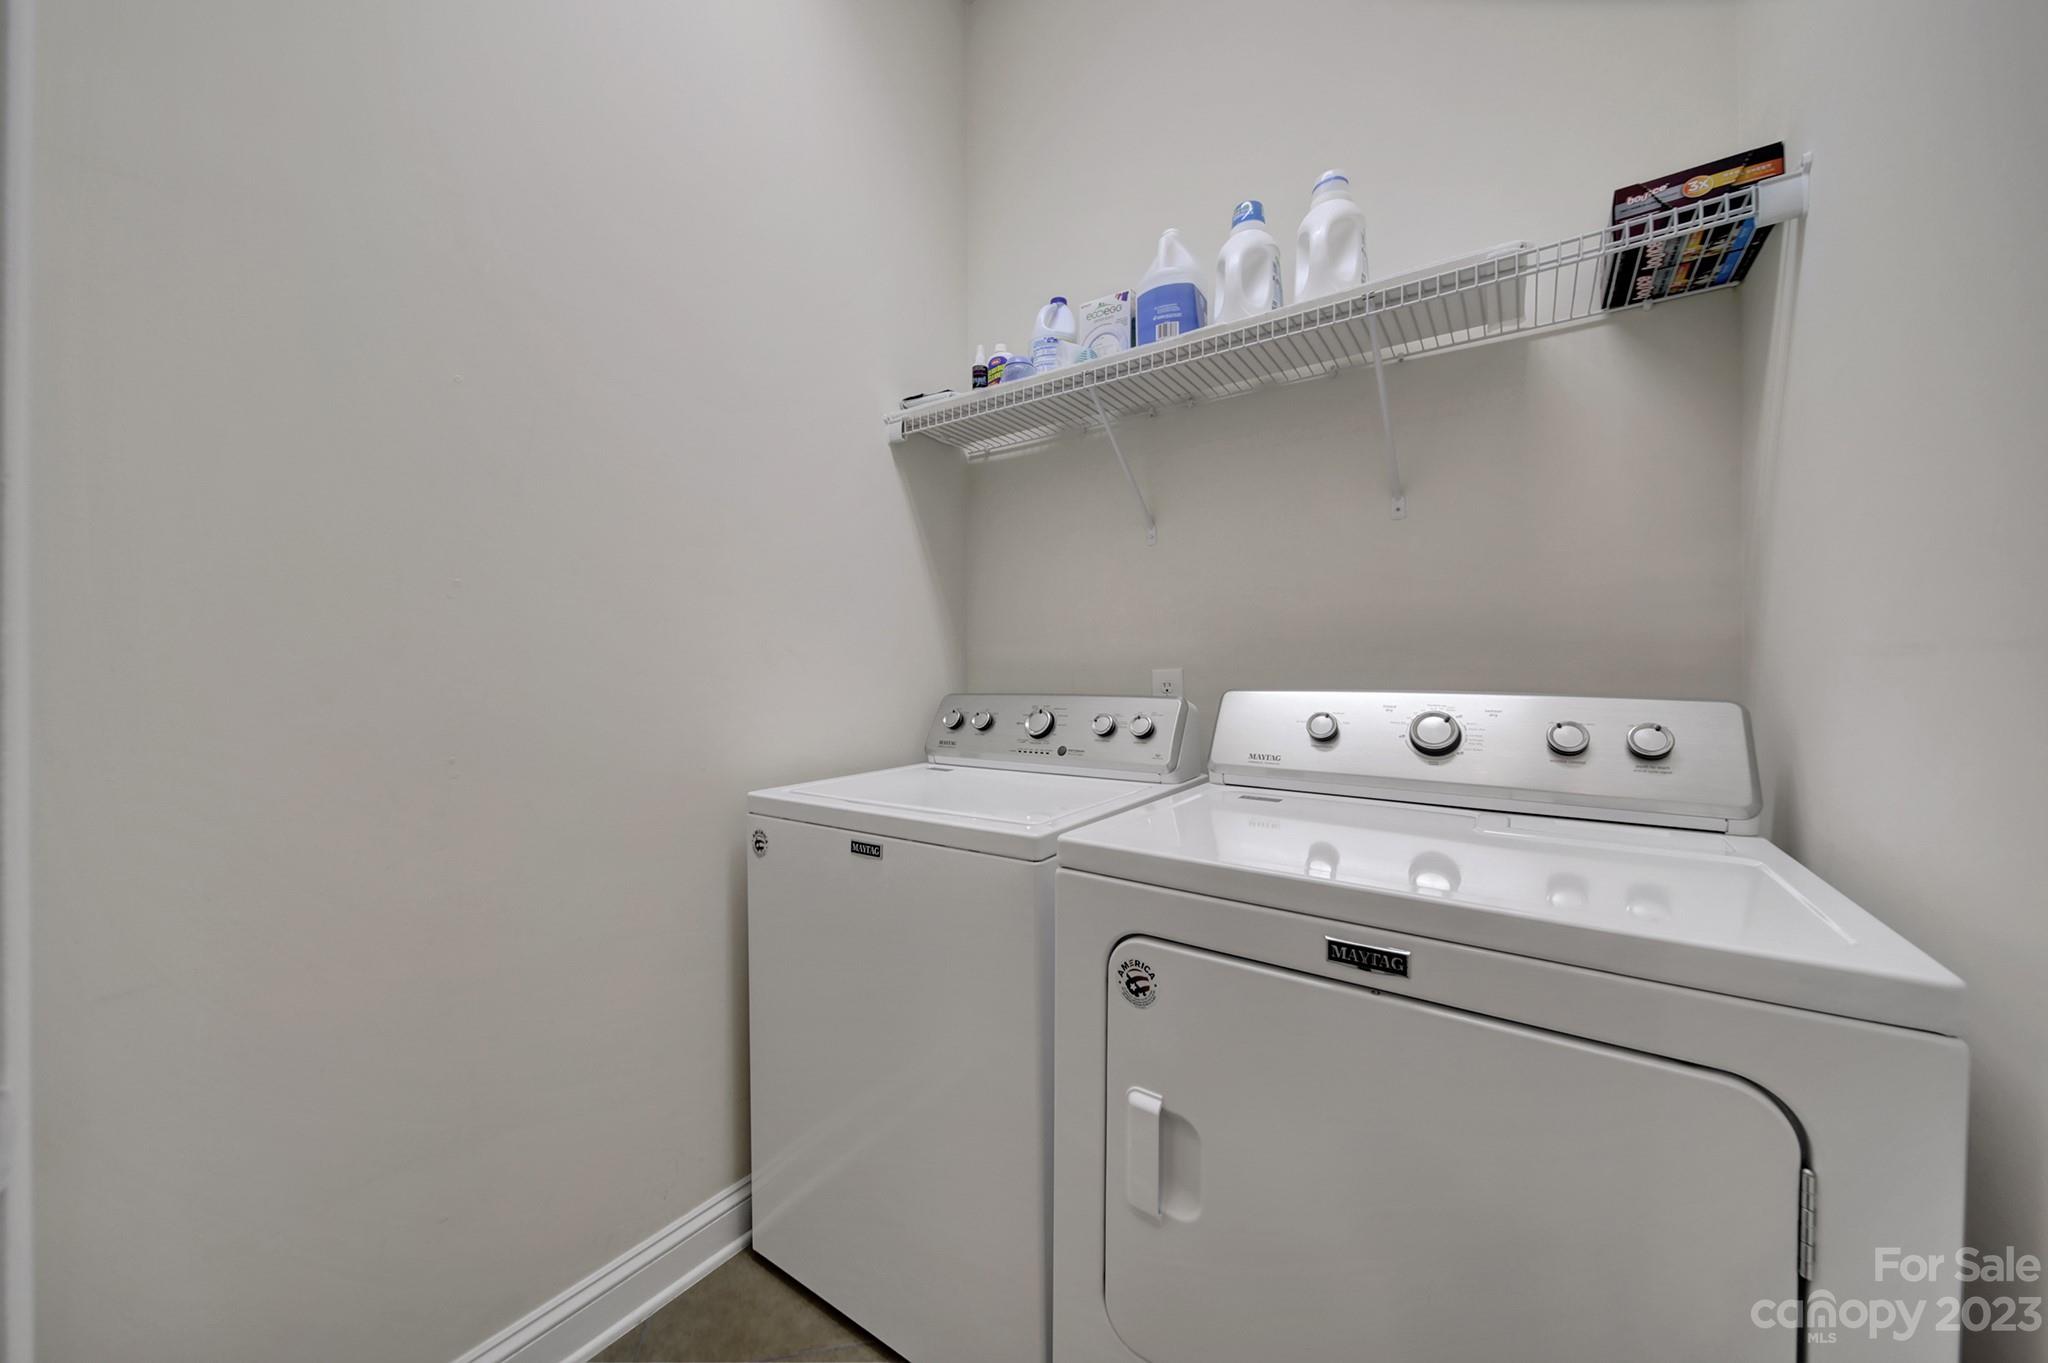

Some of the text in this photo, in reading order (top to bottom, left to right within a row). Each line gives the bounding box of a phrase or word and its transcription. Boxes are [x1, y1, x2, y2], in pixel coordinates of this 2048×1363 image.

[1248, 752, 1282, 762] MAYTAG
[851, 842, 881, 856] MAYTAG
[1330, 944, 1404, 972] MAYTAG
[1117, 959, 1156, 981] AMERICA
